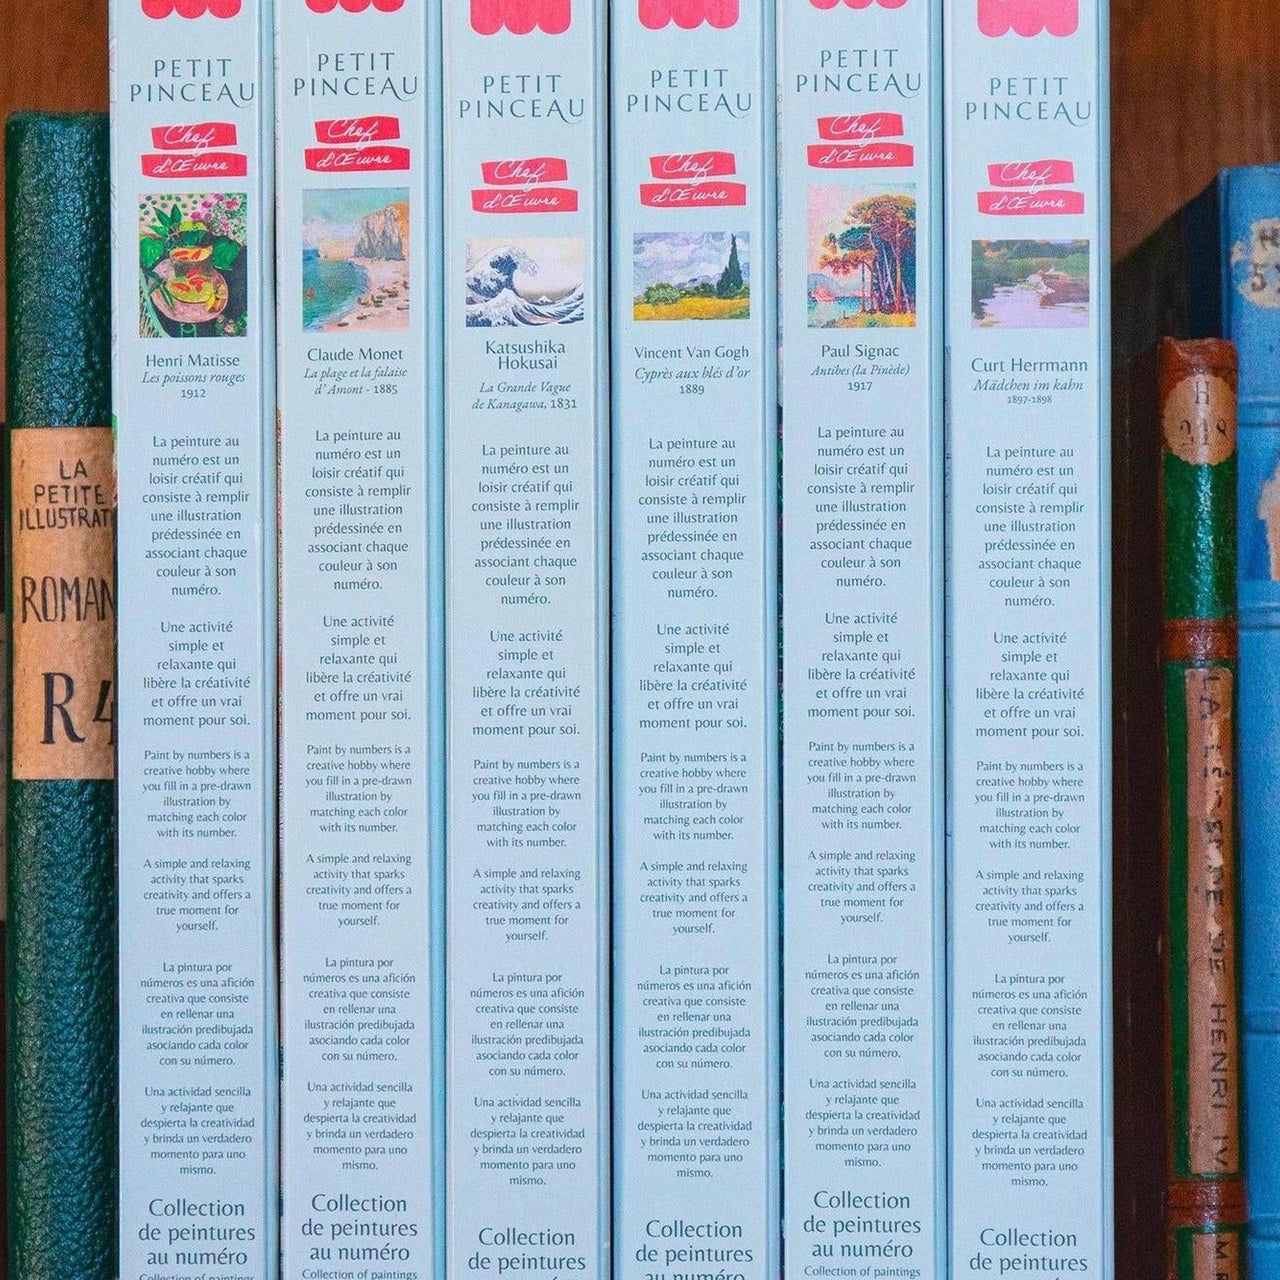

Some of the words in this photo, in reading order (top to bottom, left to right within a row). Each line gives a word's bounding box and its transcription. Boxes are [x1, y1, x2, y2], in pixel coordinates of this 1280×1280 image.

[154, 59, 232, 78] PETIT
[651, 69, 729, 88] PETIT
[130, 83, 256, 107] PINCEAU
[627, 93, 753, 119] PINCEAU
[163, 124, 215, 155] Chef
[307, 347, 354, 361] Claude
[358, 347, 404, 361] Monet
[485, 338, 566, 355] Katsushika
[633, 346, 683, 360] Vincent
[686, 345, 711, 361] Van
[714, 344, 750, 362] Gogh
[818, 343, 850, 362] Paul
[854, 343, 900, 361] Signac
[145, 353, 183, 368] Henri
[187, 353, 241, 368] Matisse
[497, 354, 558, 371] Hokusai
[970, 357, 1006, 373] Curt
[1011, 357, 1088, 375] Herrmann
[304, 367, 318, 379] La
[318, 366, 348, 383] plage
[349, 369, 359, 378] et
[360, 366, 372, 378] la
[372, 365, 408, 381] falaise
[634, 366, 673, 383] Cyprès
[675, 369, 699, 379] aux
[701, 366, 723, 379] blés
[725, 365, 751, 378] d'or
[809, 363, 852, 377] Antibes
[851, 363, 868, 378] (la
[869, 363, 911, 378] Pinède)
[141, 371, 161, 384] Les
[161, 371, 208, 388] poissons
[209, 373, 246, 387] rouges
[847, 381, 873, 393] 1917
[972, 377, 1031, 392] Mädchen
[1033, 379, 1050, 391] im
[1052, 377, 1084, 391] kahn
[180, 387, 207, 400] 1912
[313, 383, 364, 396] d'Amont
[373, 382, 399, 396] 1885
[479, 381, 495, 394] La
[496, 380, 538, 394] Grande
[540, 380, 572, 397] Vague
[679, 383, 705, 395] 1889
[1195, 381, 1209, 405] H
[471, 397, 486, 410] de
[486, 398, 548, 414] Kanagawa,
[549, 397, 578, 411] 1831
[1007, 394, 1053, 405] 1897-1898
[152, 435, 168, 448] La
[169, 435, 222, 451] peinture
[224, 437, 240, 447] au
[59, 458, 88, 480] LA
[34, 484, 105, 506] PETITE
[639, 718, 691, 729] moment
[692, 718, 724, 732] pour
[726, 716, 748, 729] soi.
[808, 740, 834, 752] Paint
[836, 740, 850, 754] by
[852, 740, 896, 753] numbers
[898, 741, 909, 752] is
[908, 743, 916, 752] a
[1210, 1002, 1228, 1109] HENRI
[311, 1192, 407, 1213] Collection
[301, 1217, 325, 1237] de
[328, 1218, 418, 1241] peintures
[309, 1246, 332, 1261] au
[337, 1242, 410, 1262] numéro
